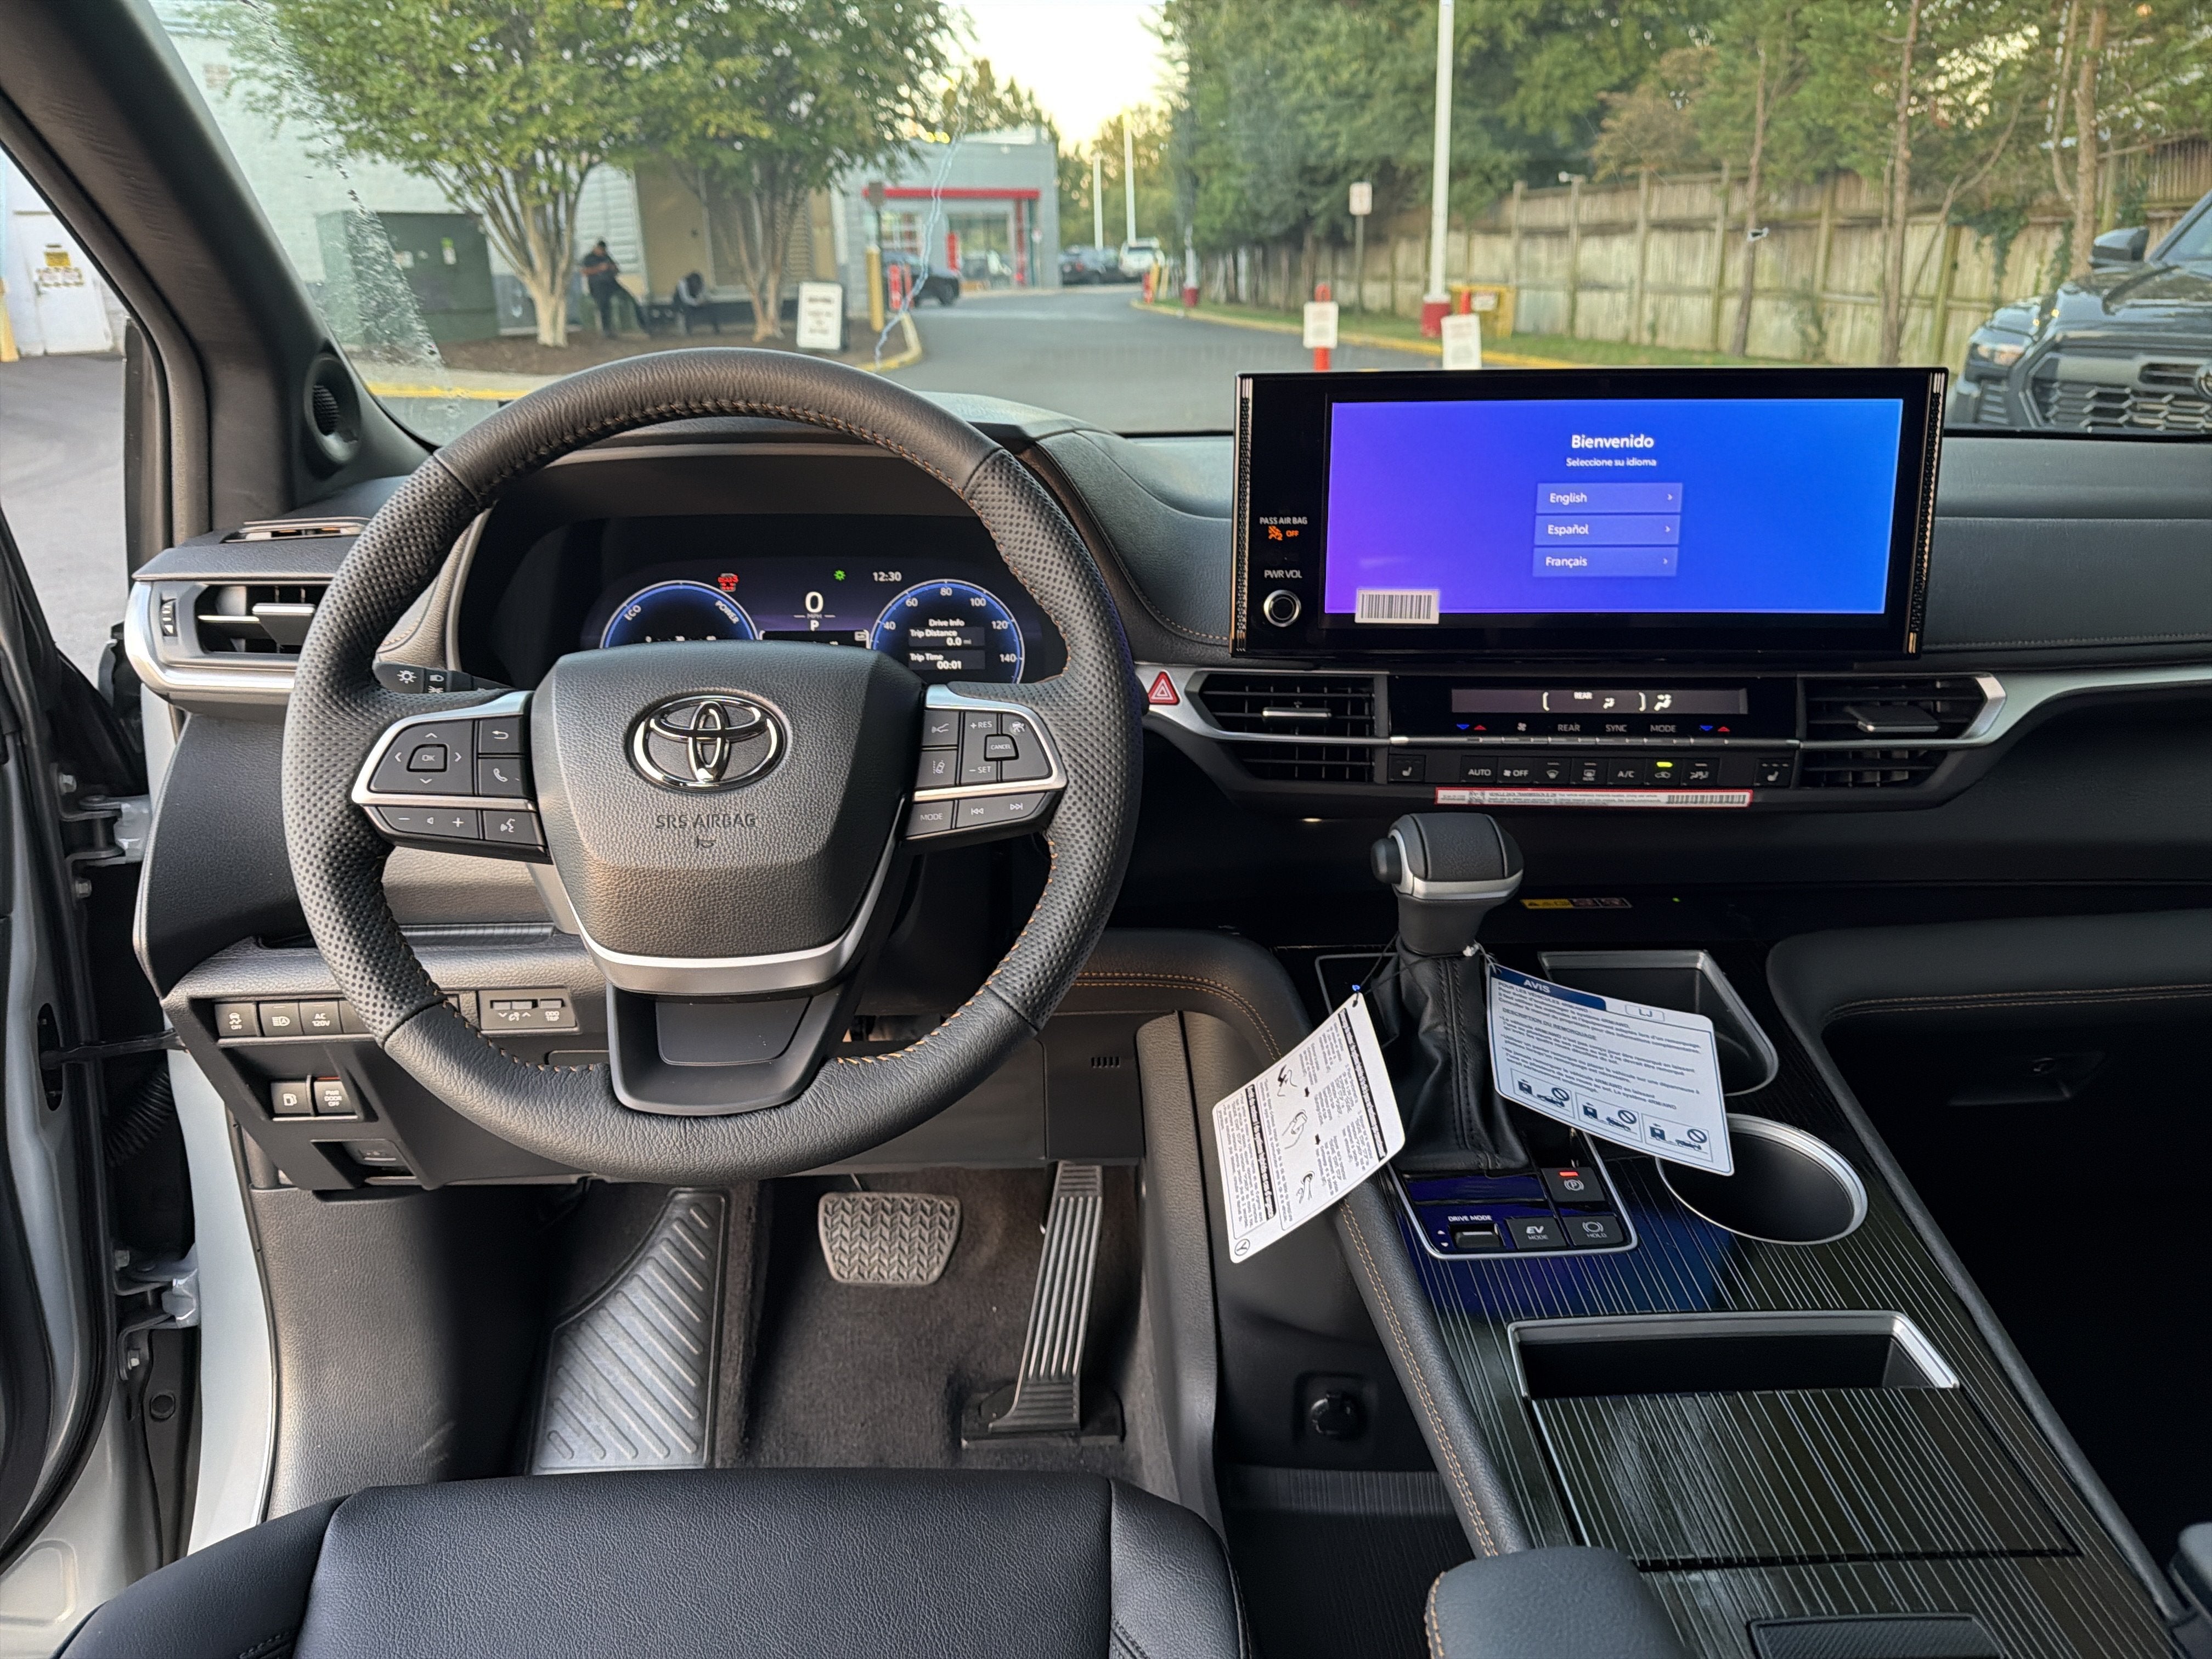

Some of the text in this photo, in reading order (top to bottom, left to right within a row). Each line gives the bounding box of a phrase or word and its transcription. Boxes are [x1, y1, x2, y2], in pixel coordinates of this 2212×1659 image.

[1571, 434, 1654, 449] Bienvenido
[1565, 458, 1613, 467] Seleccione
[1626, 458, 1657, 467] idioma
[1549, 493, 1588, 505] English
[1278, 516, 1291, 524] AIR
[1292, 516, 1308, 524] BAG
[1548, 524, 1589, 536] Español
[1545, 556, 1588, 568] Français
[872, 572, 902, 582] 12:30
[1264, 569, 1302, 579] PWR VOL
[940, 588, 952, 596] 80
[805, 591, 823, 613] 0
[906, 598, 918, 607] 60
[970, 598, 986, 607] 100
[624, 605, 641, 620] ECO
[715, 600, 740, 624] POWER
[810, 620, 819, 630] P
[884, 622, 896, 630] 40
[991, 620, 1008, 629] 120
[910, 629, 924, 637] Trip
[946, 637, 962, 646] 0.0
[1000, 654, 1016, 662] 140
[936, 661, 962, 670] 00:01
[1573, 691, 1593, 699] REAR
[1605, 724, 1628, 732] SYNC
[1650, 724, 1677, 732] MODE
[656, 813, 758, 829] SRS AIRBAG
[1523, 979, 1551, 994] AVIS
[1526, 1226, 1544, 1234] EV
